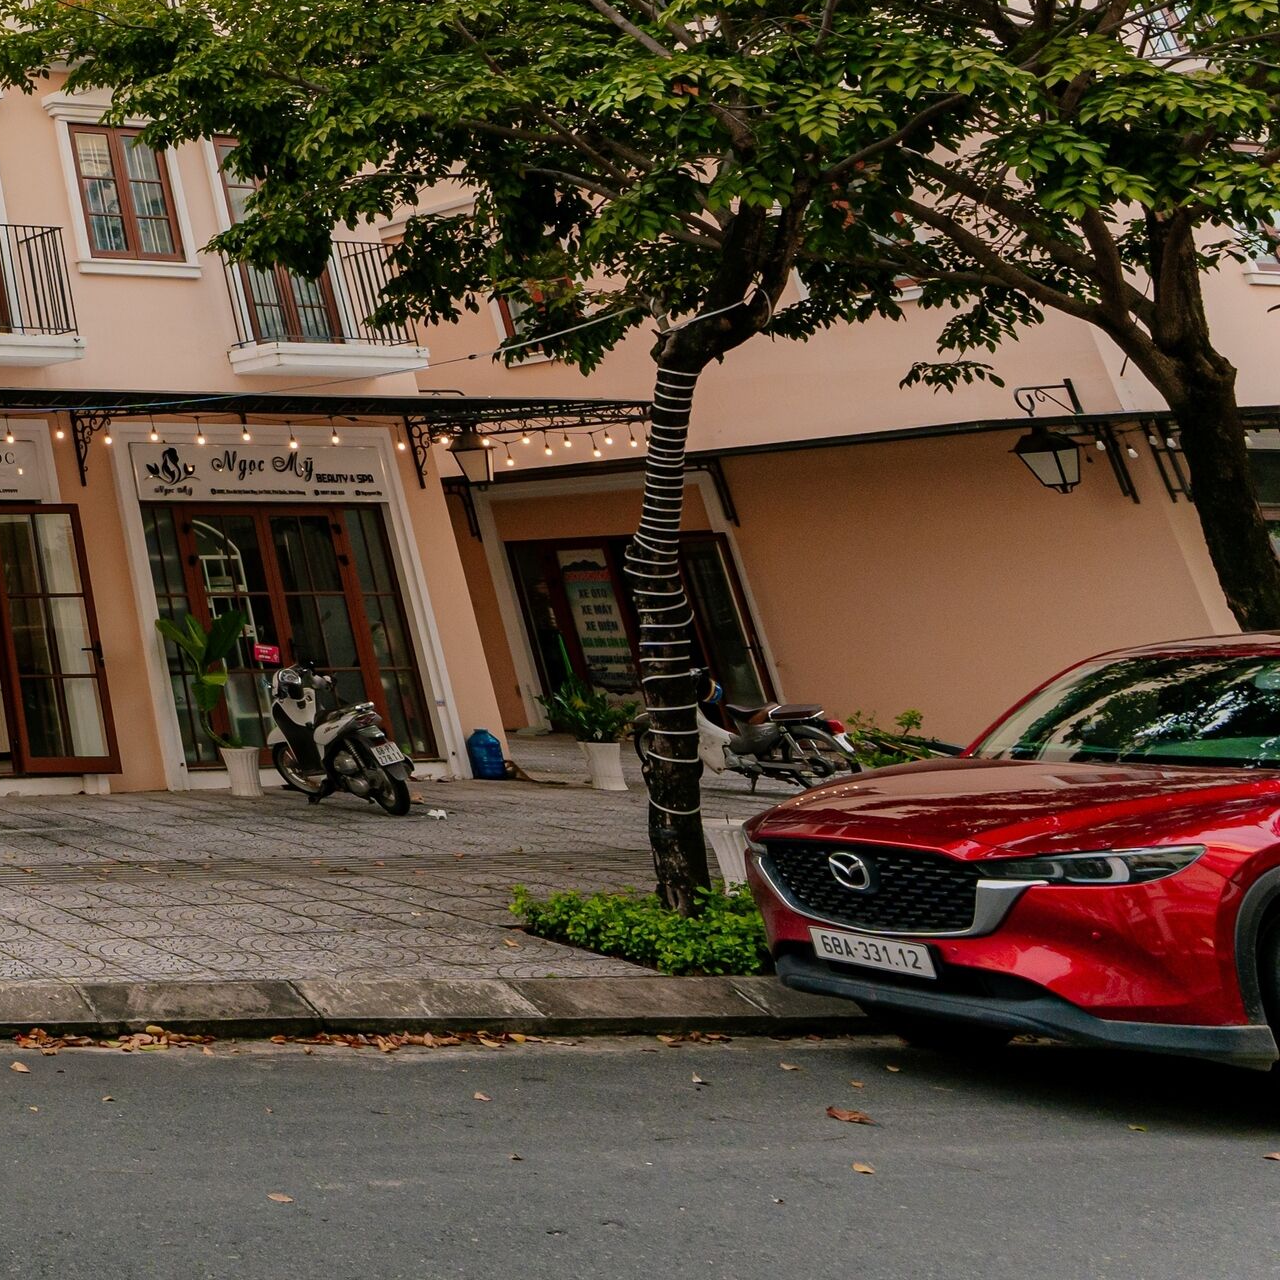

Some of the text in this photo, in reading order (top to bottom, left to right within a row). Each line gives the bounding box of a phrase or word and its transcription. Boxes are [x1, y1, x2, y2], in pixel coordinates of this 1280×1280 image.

[211, 449, 314, 482] Ngọc Mỹ
[316, 473, 375, 484] BEAUTY & SPA
[579, 589, 590, 598] XE
[582, 605, 593, 615] XE
[585, 621, 596, 631] XE
[820, 934, 922, 970] 68A-331.12
